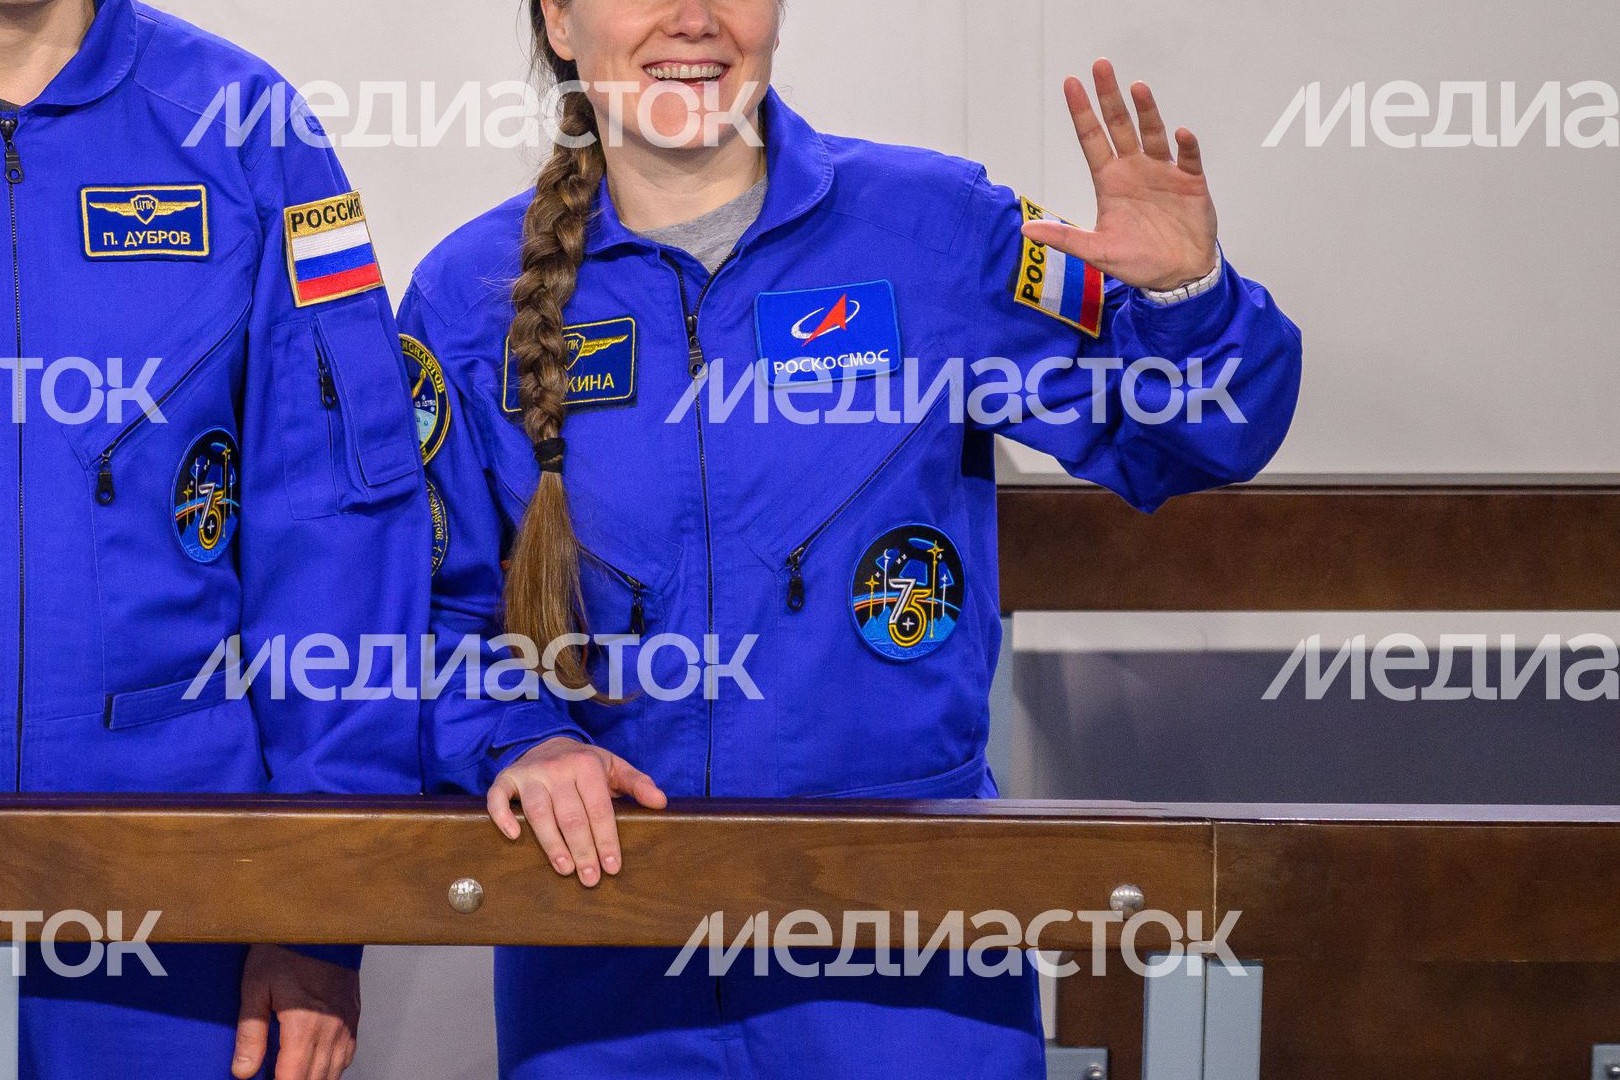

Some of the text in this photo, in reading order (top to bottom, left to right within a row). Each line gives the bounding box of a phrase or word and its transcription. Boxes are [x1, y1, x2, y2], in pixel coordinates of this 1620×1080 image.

[134, 200, 154, 211] ЦПК
[290, 198, 363, 232] РОССИЯ
[103, 230, 191, 247] П. ДУБРОВ
[1021, 202, 1044, 304] РОСЯ
[773, 348, 889, 375] РОСКОСМОС
[568, 372, 615, 392] КИНА
[888, 578, 932, 647] 75
